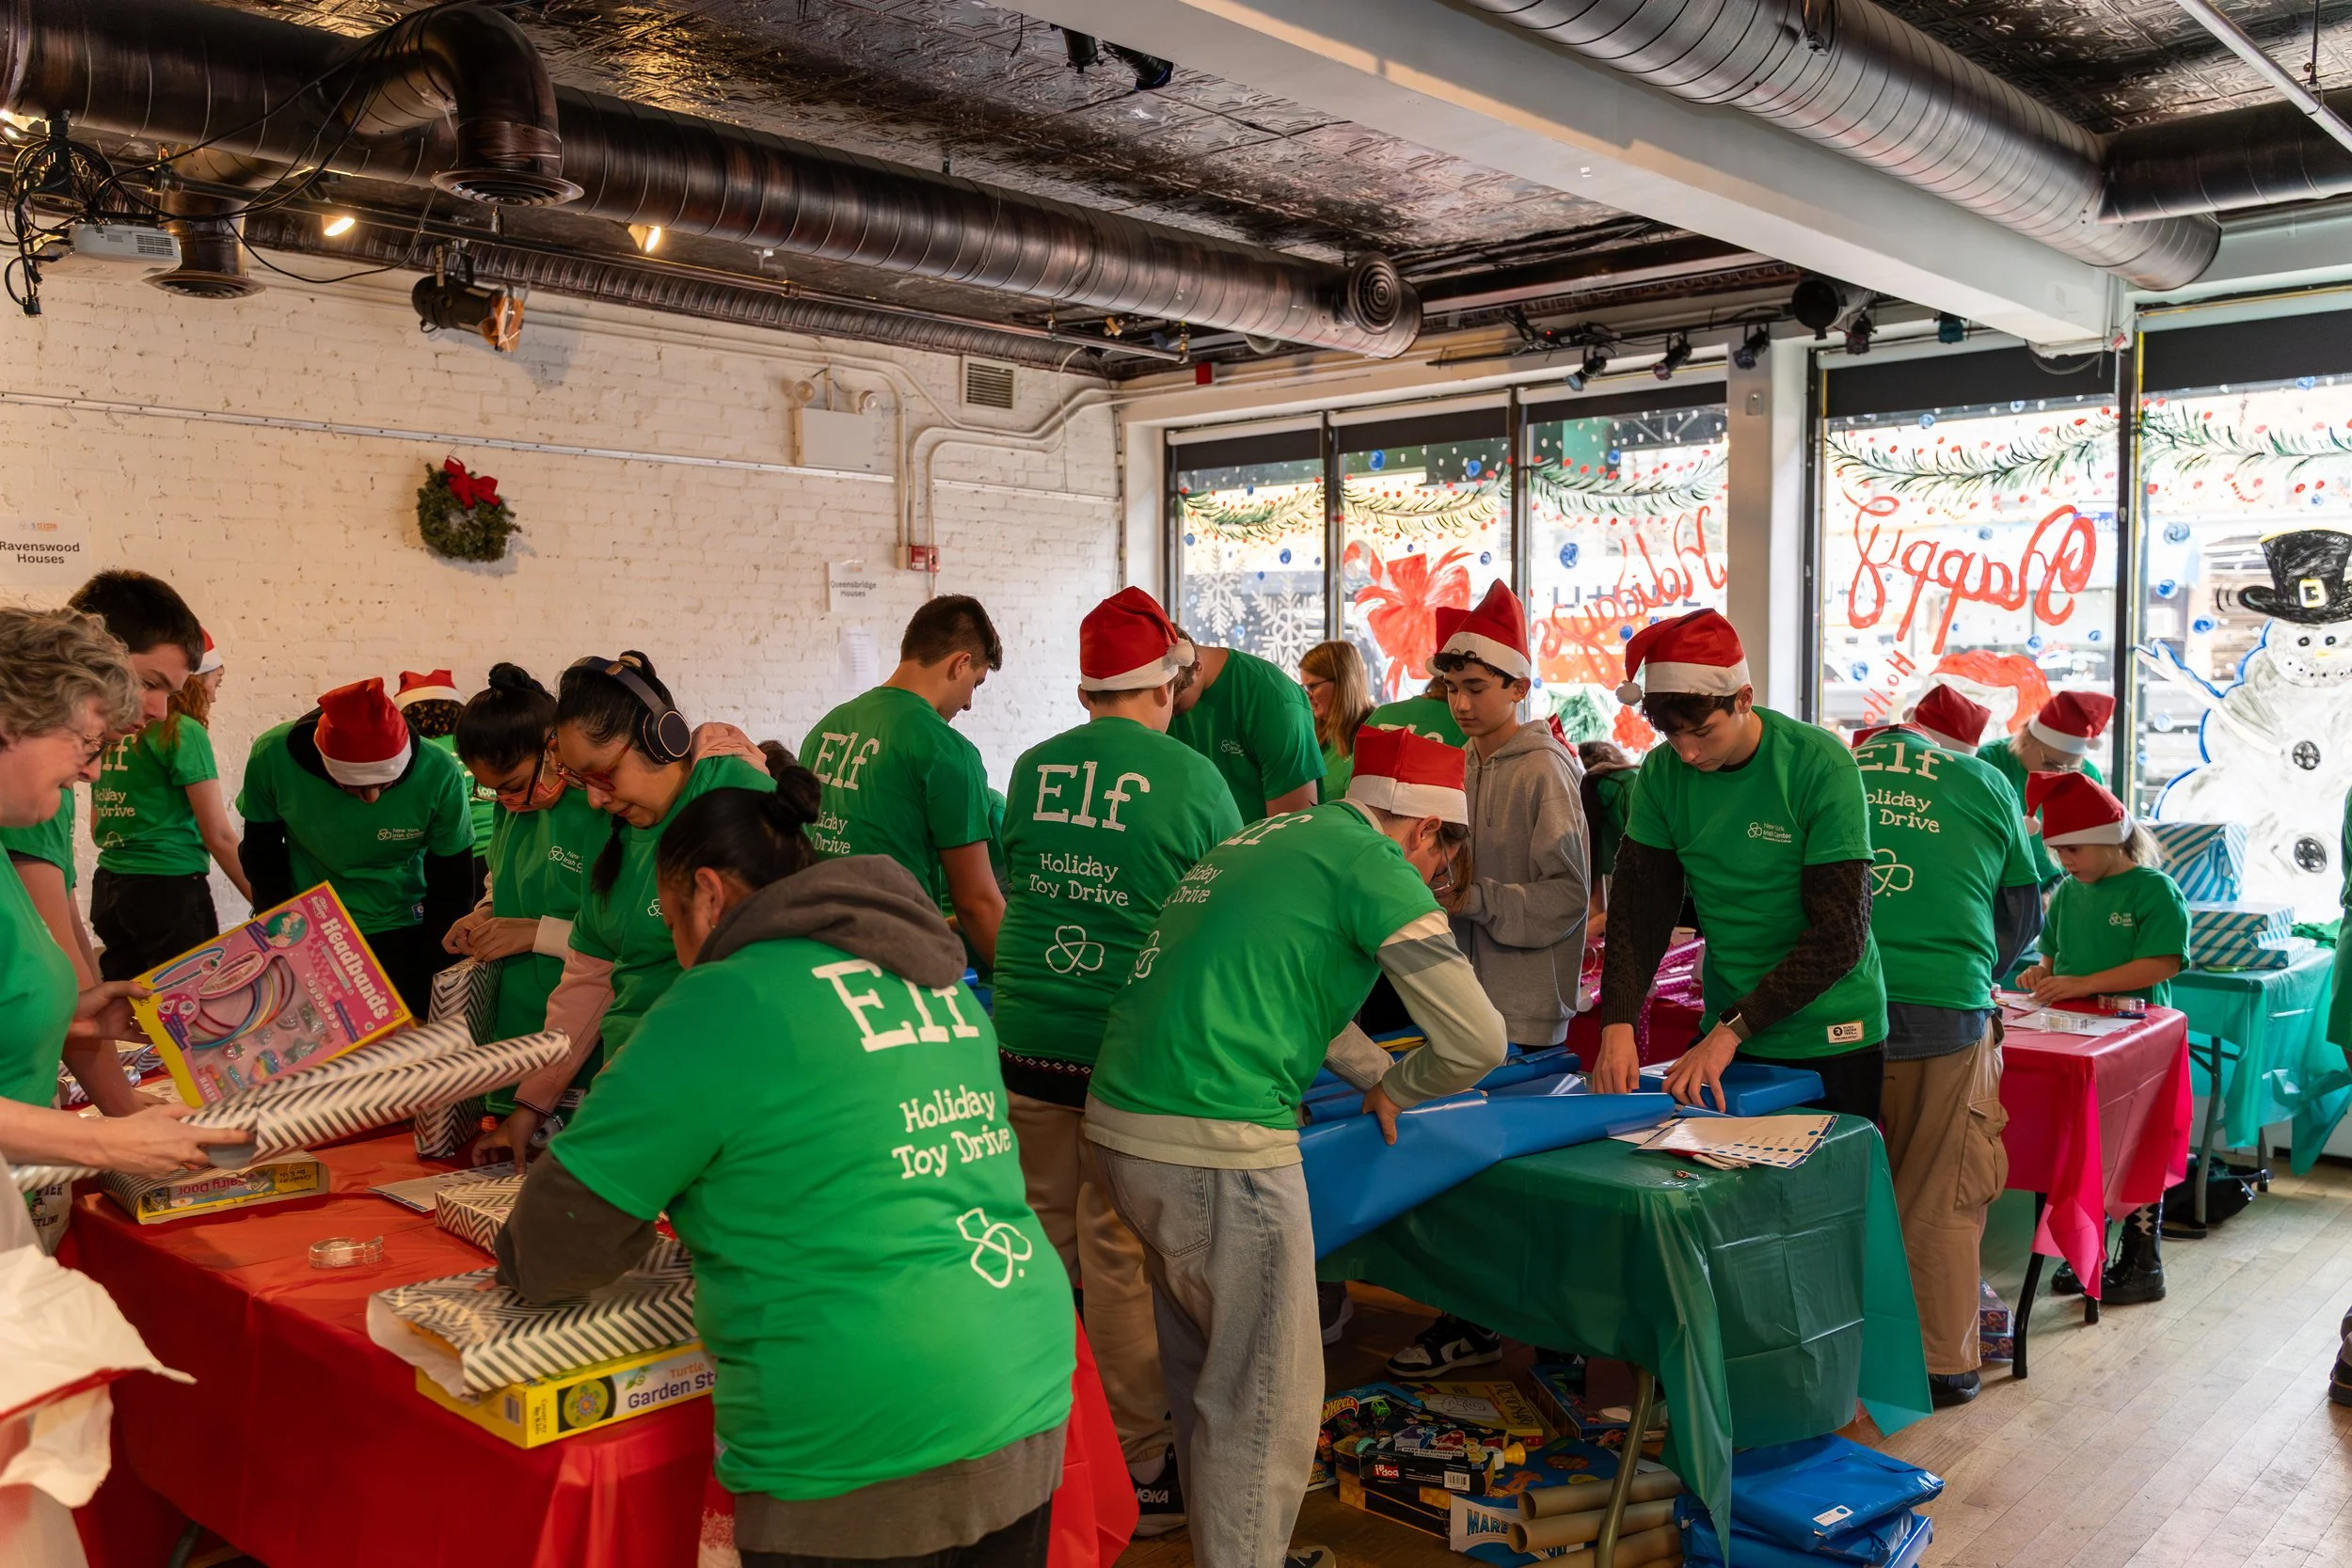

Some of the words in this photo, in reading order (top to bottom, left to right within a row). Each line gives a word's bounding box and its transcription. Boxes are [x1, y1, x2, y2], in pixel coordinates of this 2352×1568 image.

[0, 541, 80, 552] Ravenswood
[17, 553, 65, 564] Houses
[102, 734, 136, 771] lf
[813, 732, 880, 791] Elf
[1851, 742, 1955, 781] Elf
[1033, 760, 1151, 832] Elf
[1866, 788, 1931, 813] oliday
[813, 810, 848, 835] liday
[1217, 812, 1314, 847] lf
[1879, 808, 1940, 833] Drive
[815, 832, 851, 855] Drive
[1039, 853, 1120, 883] Holiday
[1181, 863, 1224, 885] liday
[1028, 874, 1061, 899] Toy
[1068, 879, 1130, 907] Drive
[1172, 885, 1212, 904] Drive
[320, 917, 389, 1021] Headbands
[899, 1085, 996, 1133] Holiday
[891, 1145, 948, 1180] Toy
[950, 1125, 1012, 1164] Drive
[177, 1179, 210, 1196] Door
[670, 1362, 705, 1379] Turtle
[628, 1380, 691, 1410] Garden
[694, 1370, 718, 1390] St
[1381, 1467, 1399, 1479] bop
